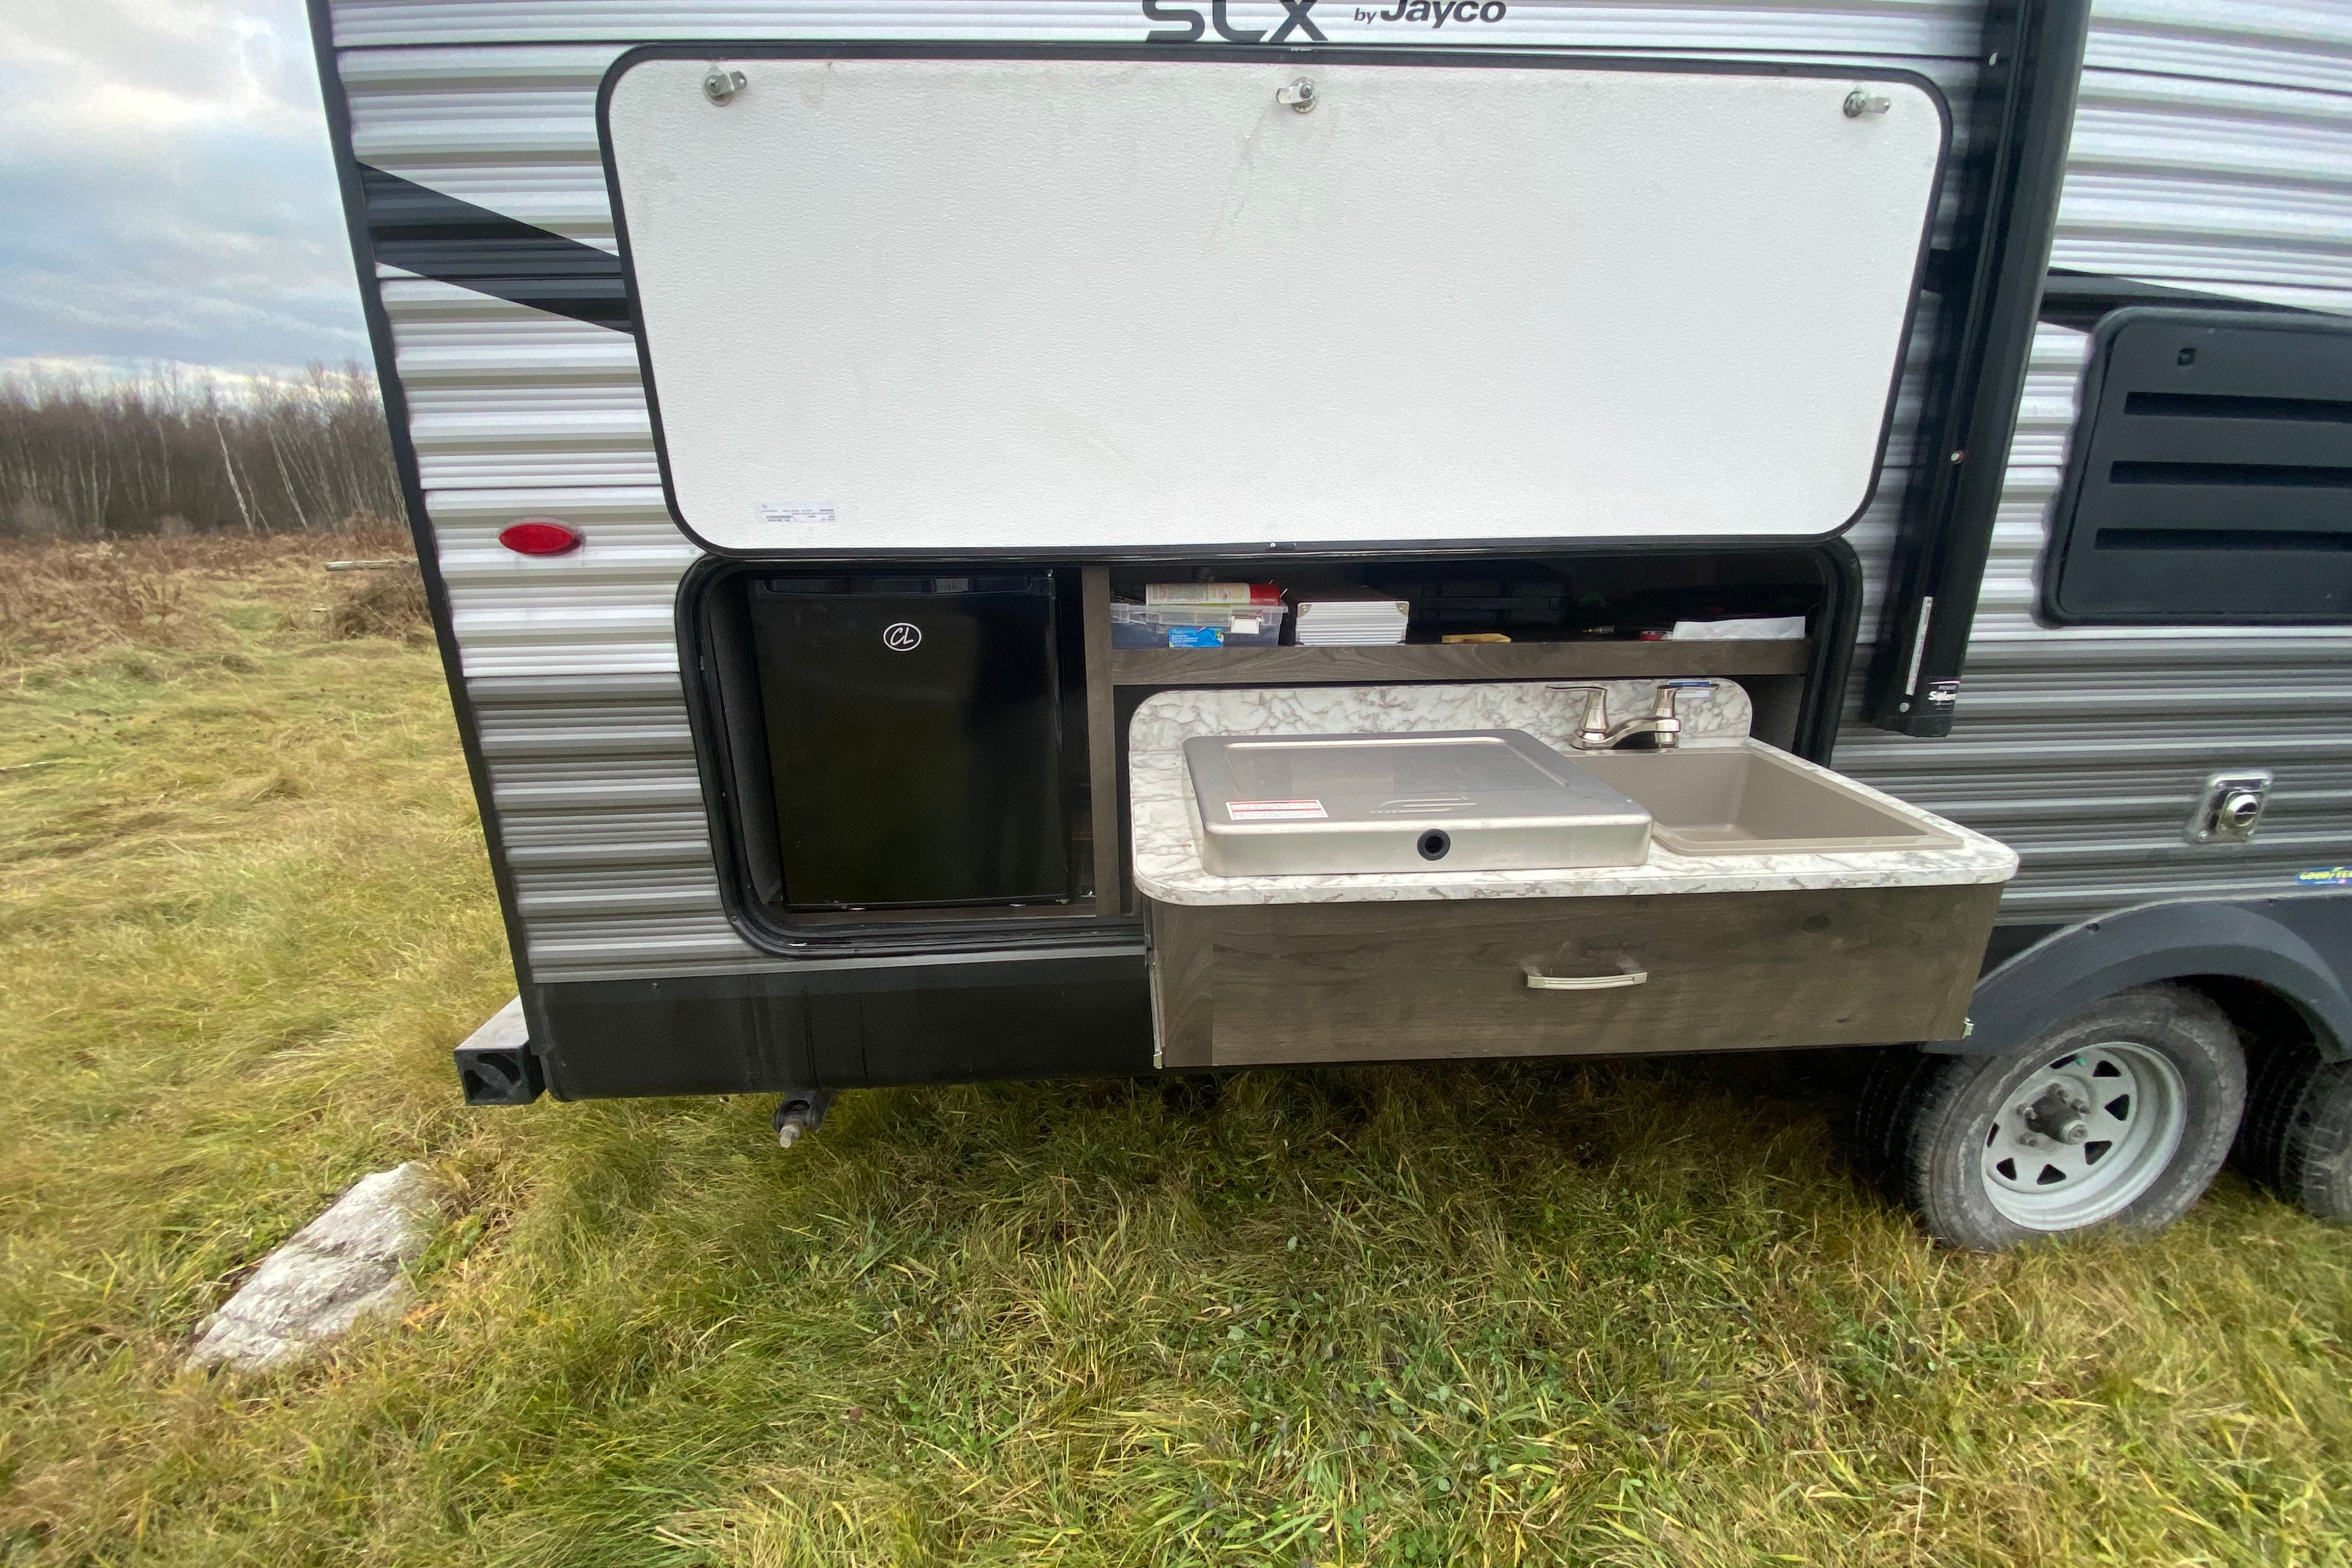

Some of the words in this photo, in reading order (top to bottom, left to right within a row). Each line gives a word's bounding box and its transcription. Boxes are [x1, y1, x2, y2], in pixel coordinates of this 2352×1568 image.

[1354, 8, 1377, 24] by
[1380, 0, 1507, 29] Jayco
[890, 626, 914, 646] CL
